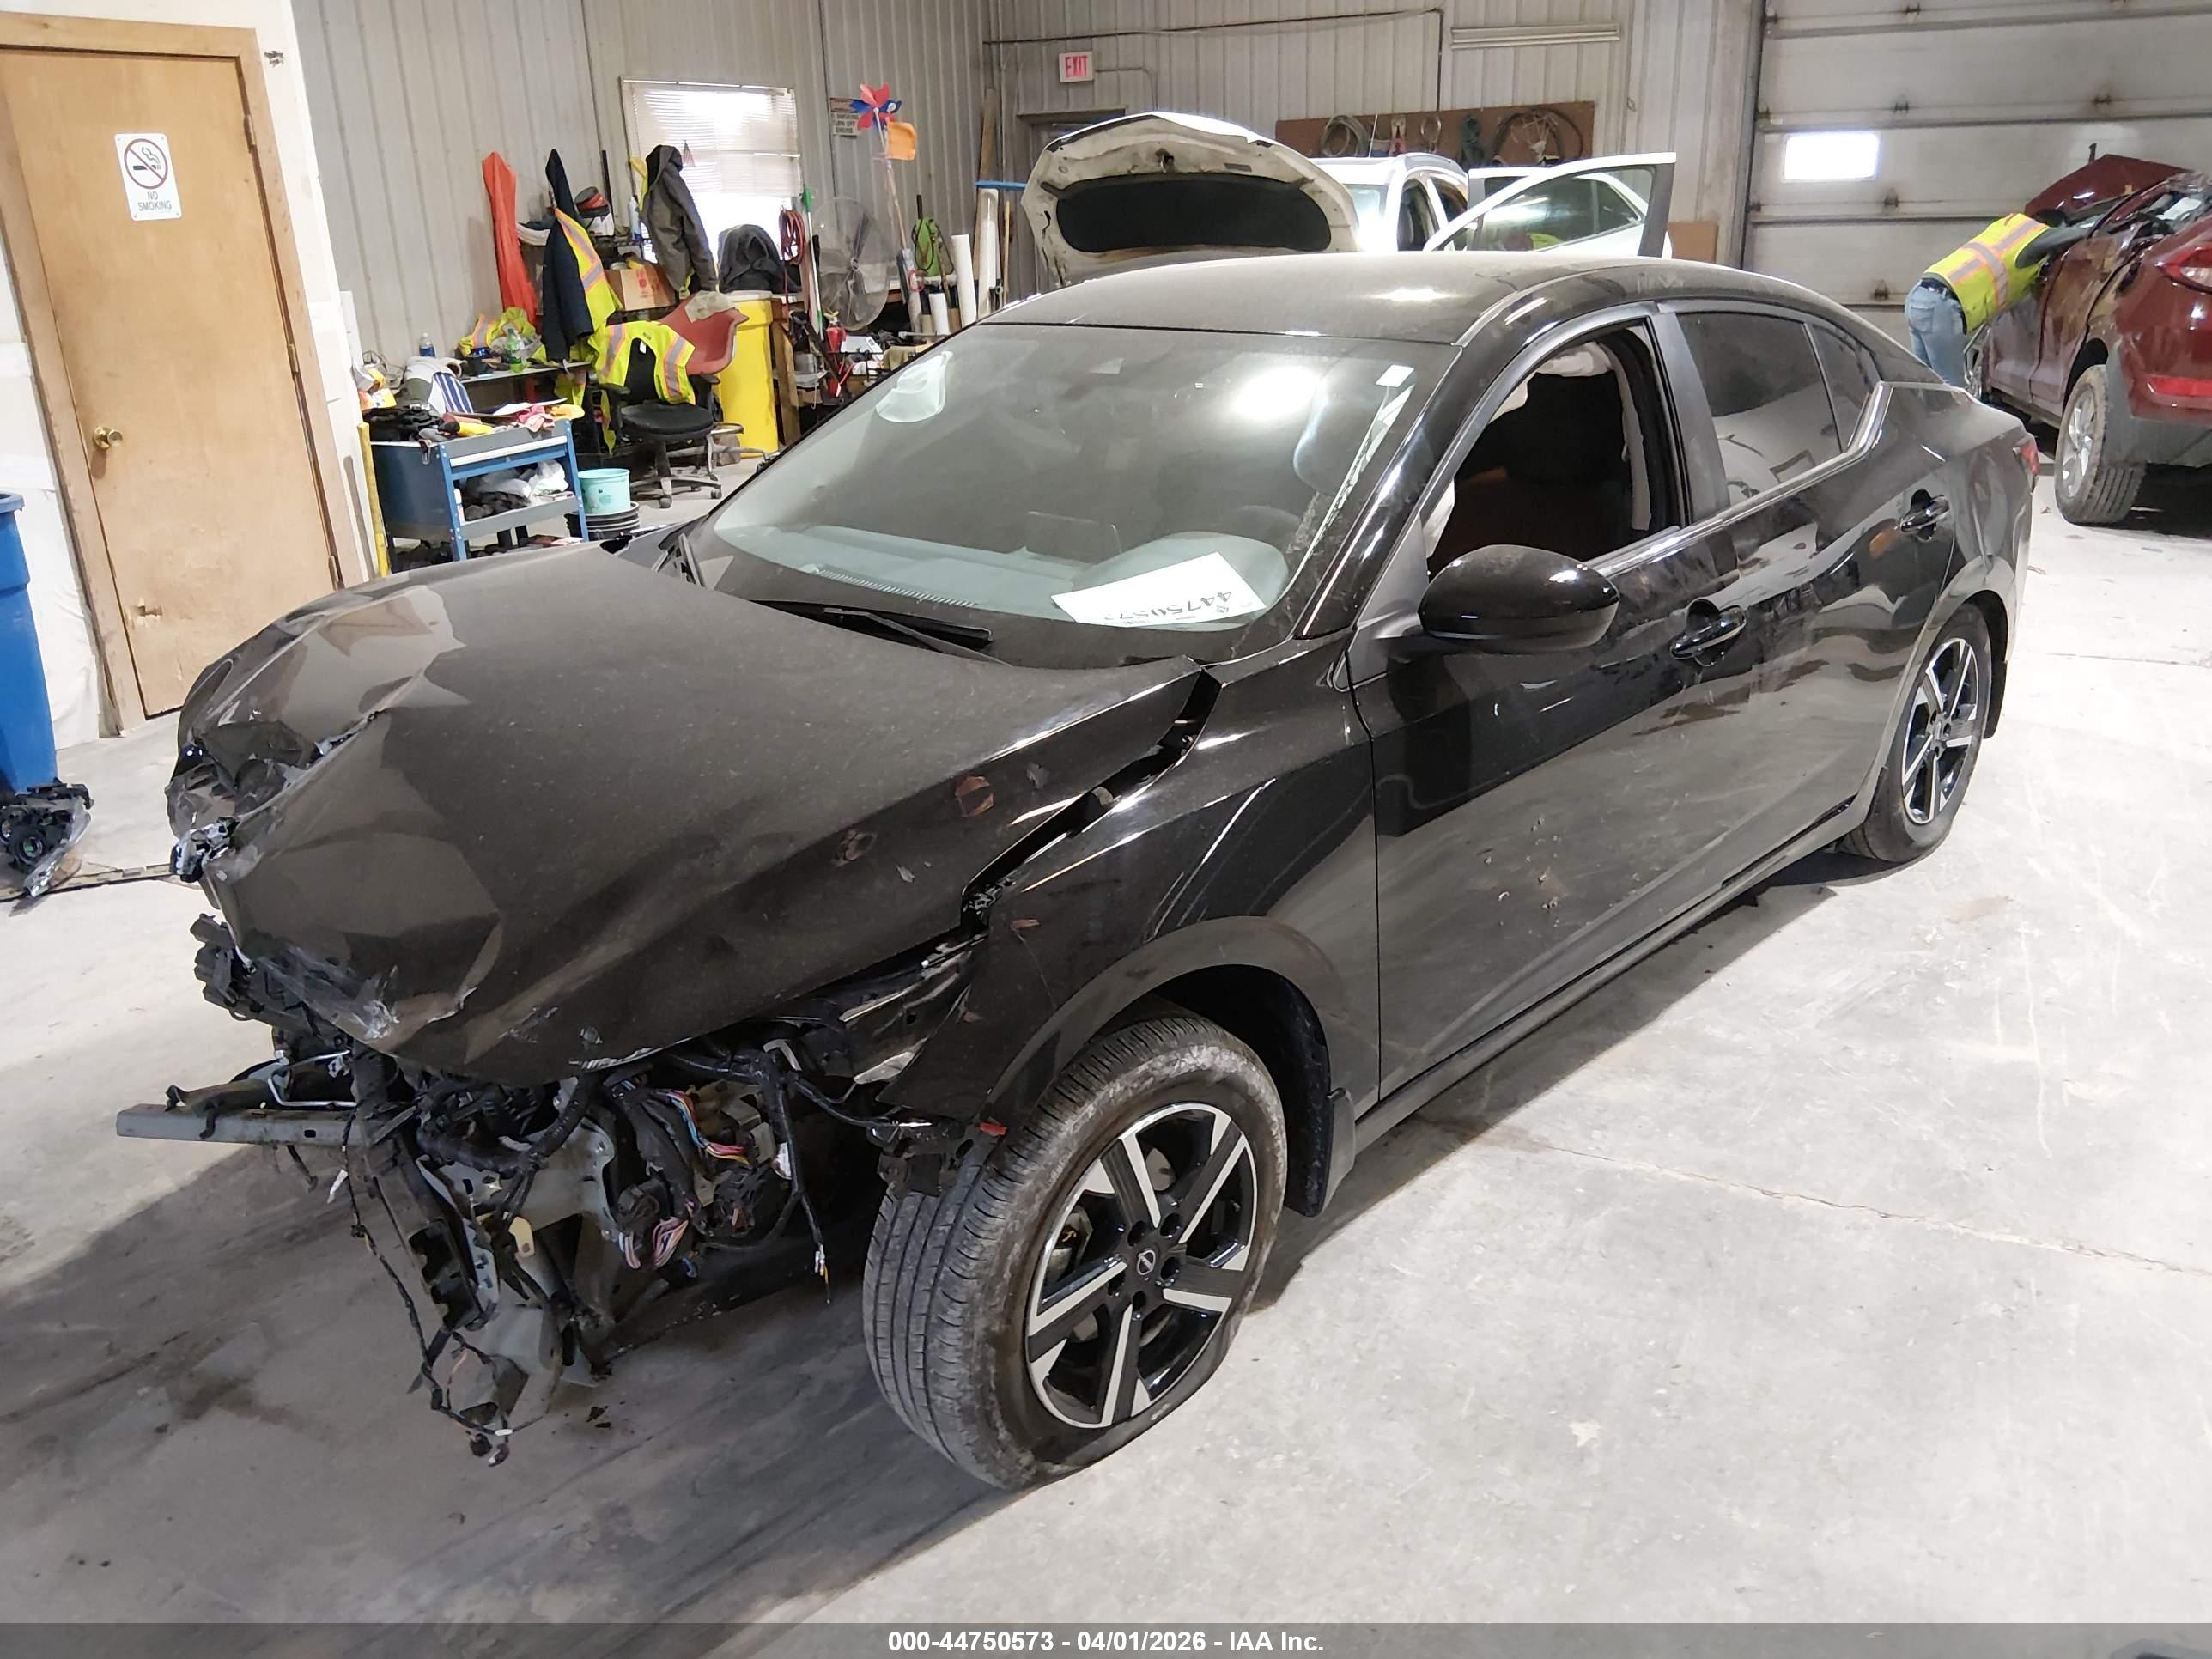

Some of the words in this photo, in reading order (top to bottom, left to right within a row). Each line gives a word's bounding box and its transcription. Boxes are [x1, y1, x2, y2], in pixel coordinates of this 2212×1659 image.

[1065, 55, 1088, 77] EXIT
[147, 191, 159, 200] NO
[137, 200, 173, 211] SMOKING
